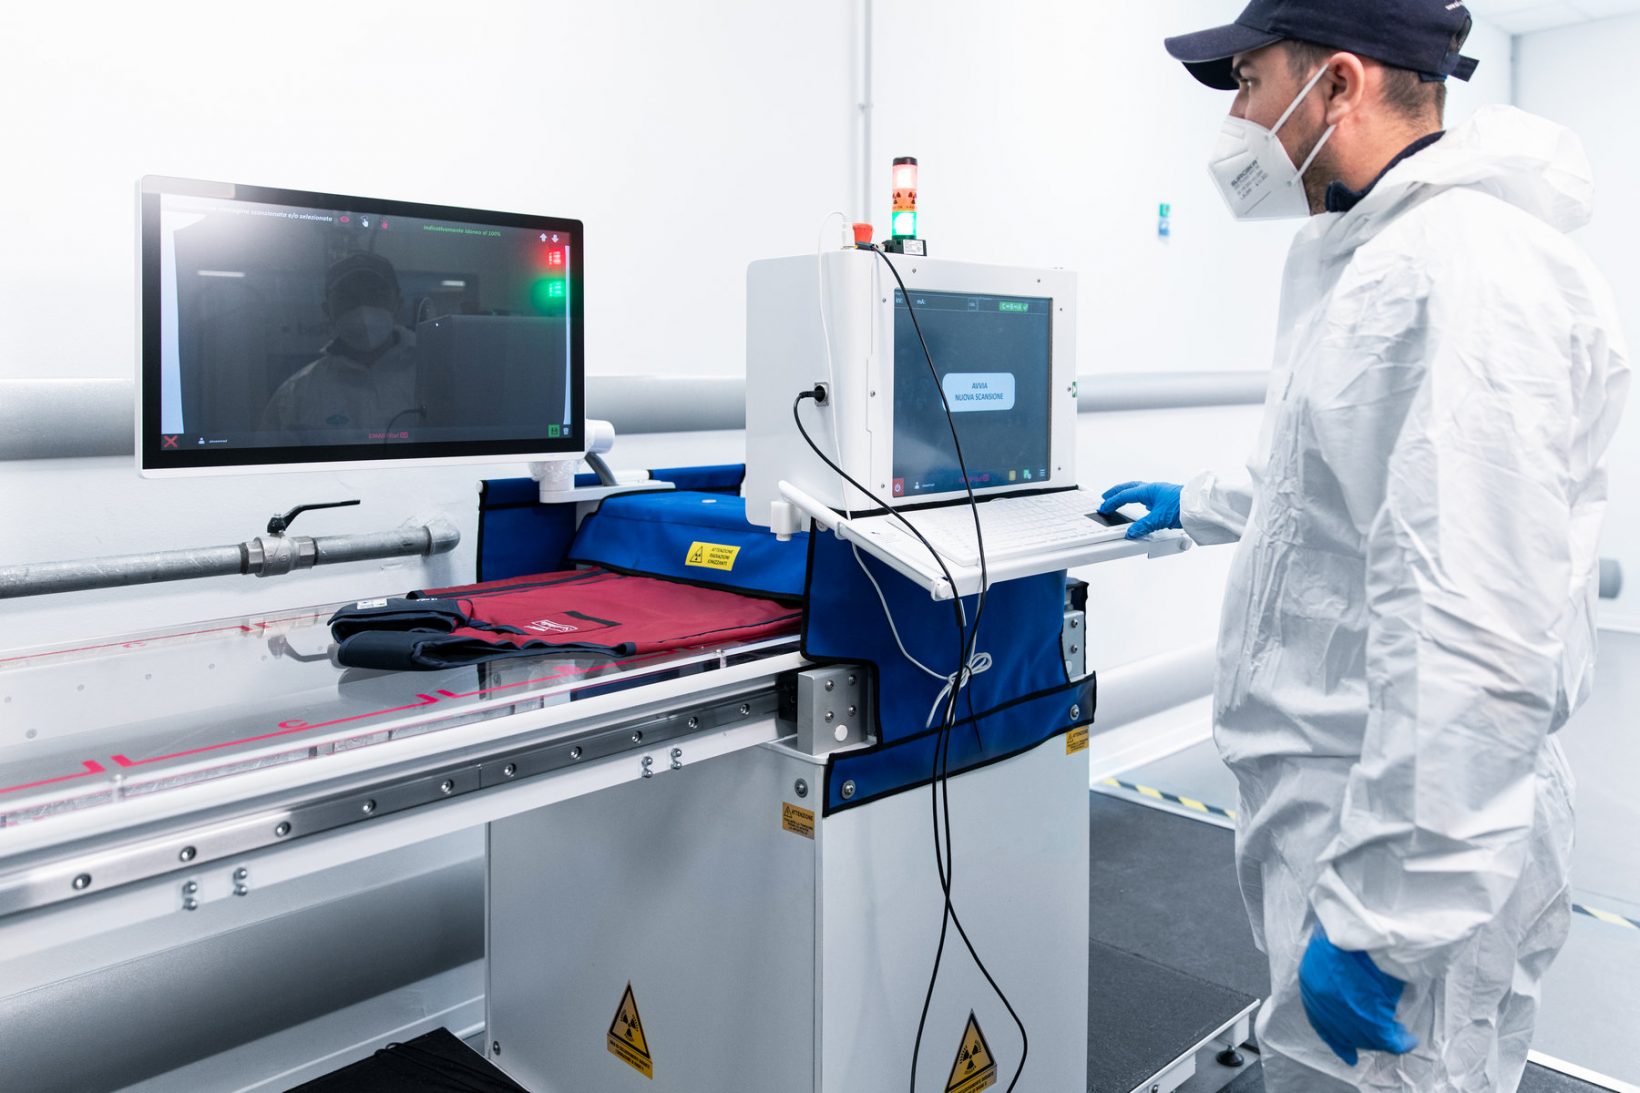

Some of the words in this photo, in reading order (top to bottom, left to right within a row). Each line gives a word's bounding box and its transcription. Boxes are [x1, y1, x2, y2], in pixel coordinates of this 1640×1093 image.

[971, 382, 988, 390] AVVIA
[955, 393, 974, 401] NUOVA
[975, 392, 1004, 401] SCANSIONE
